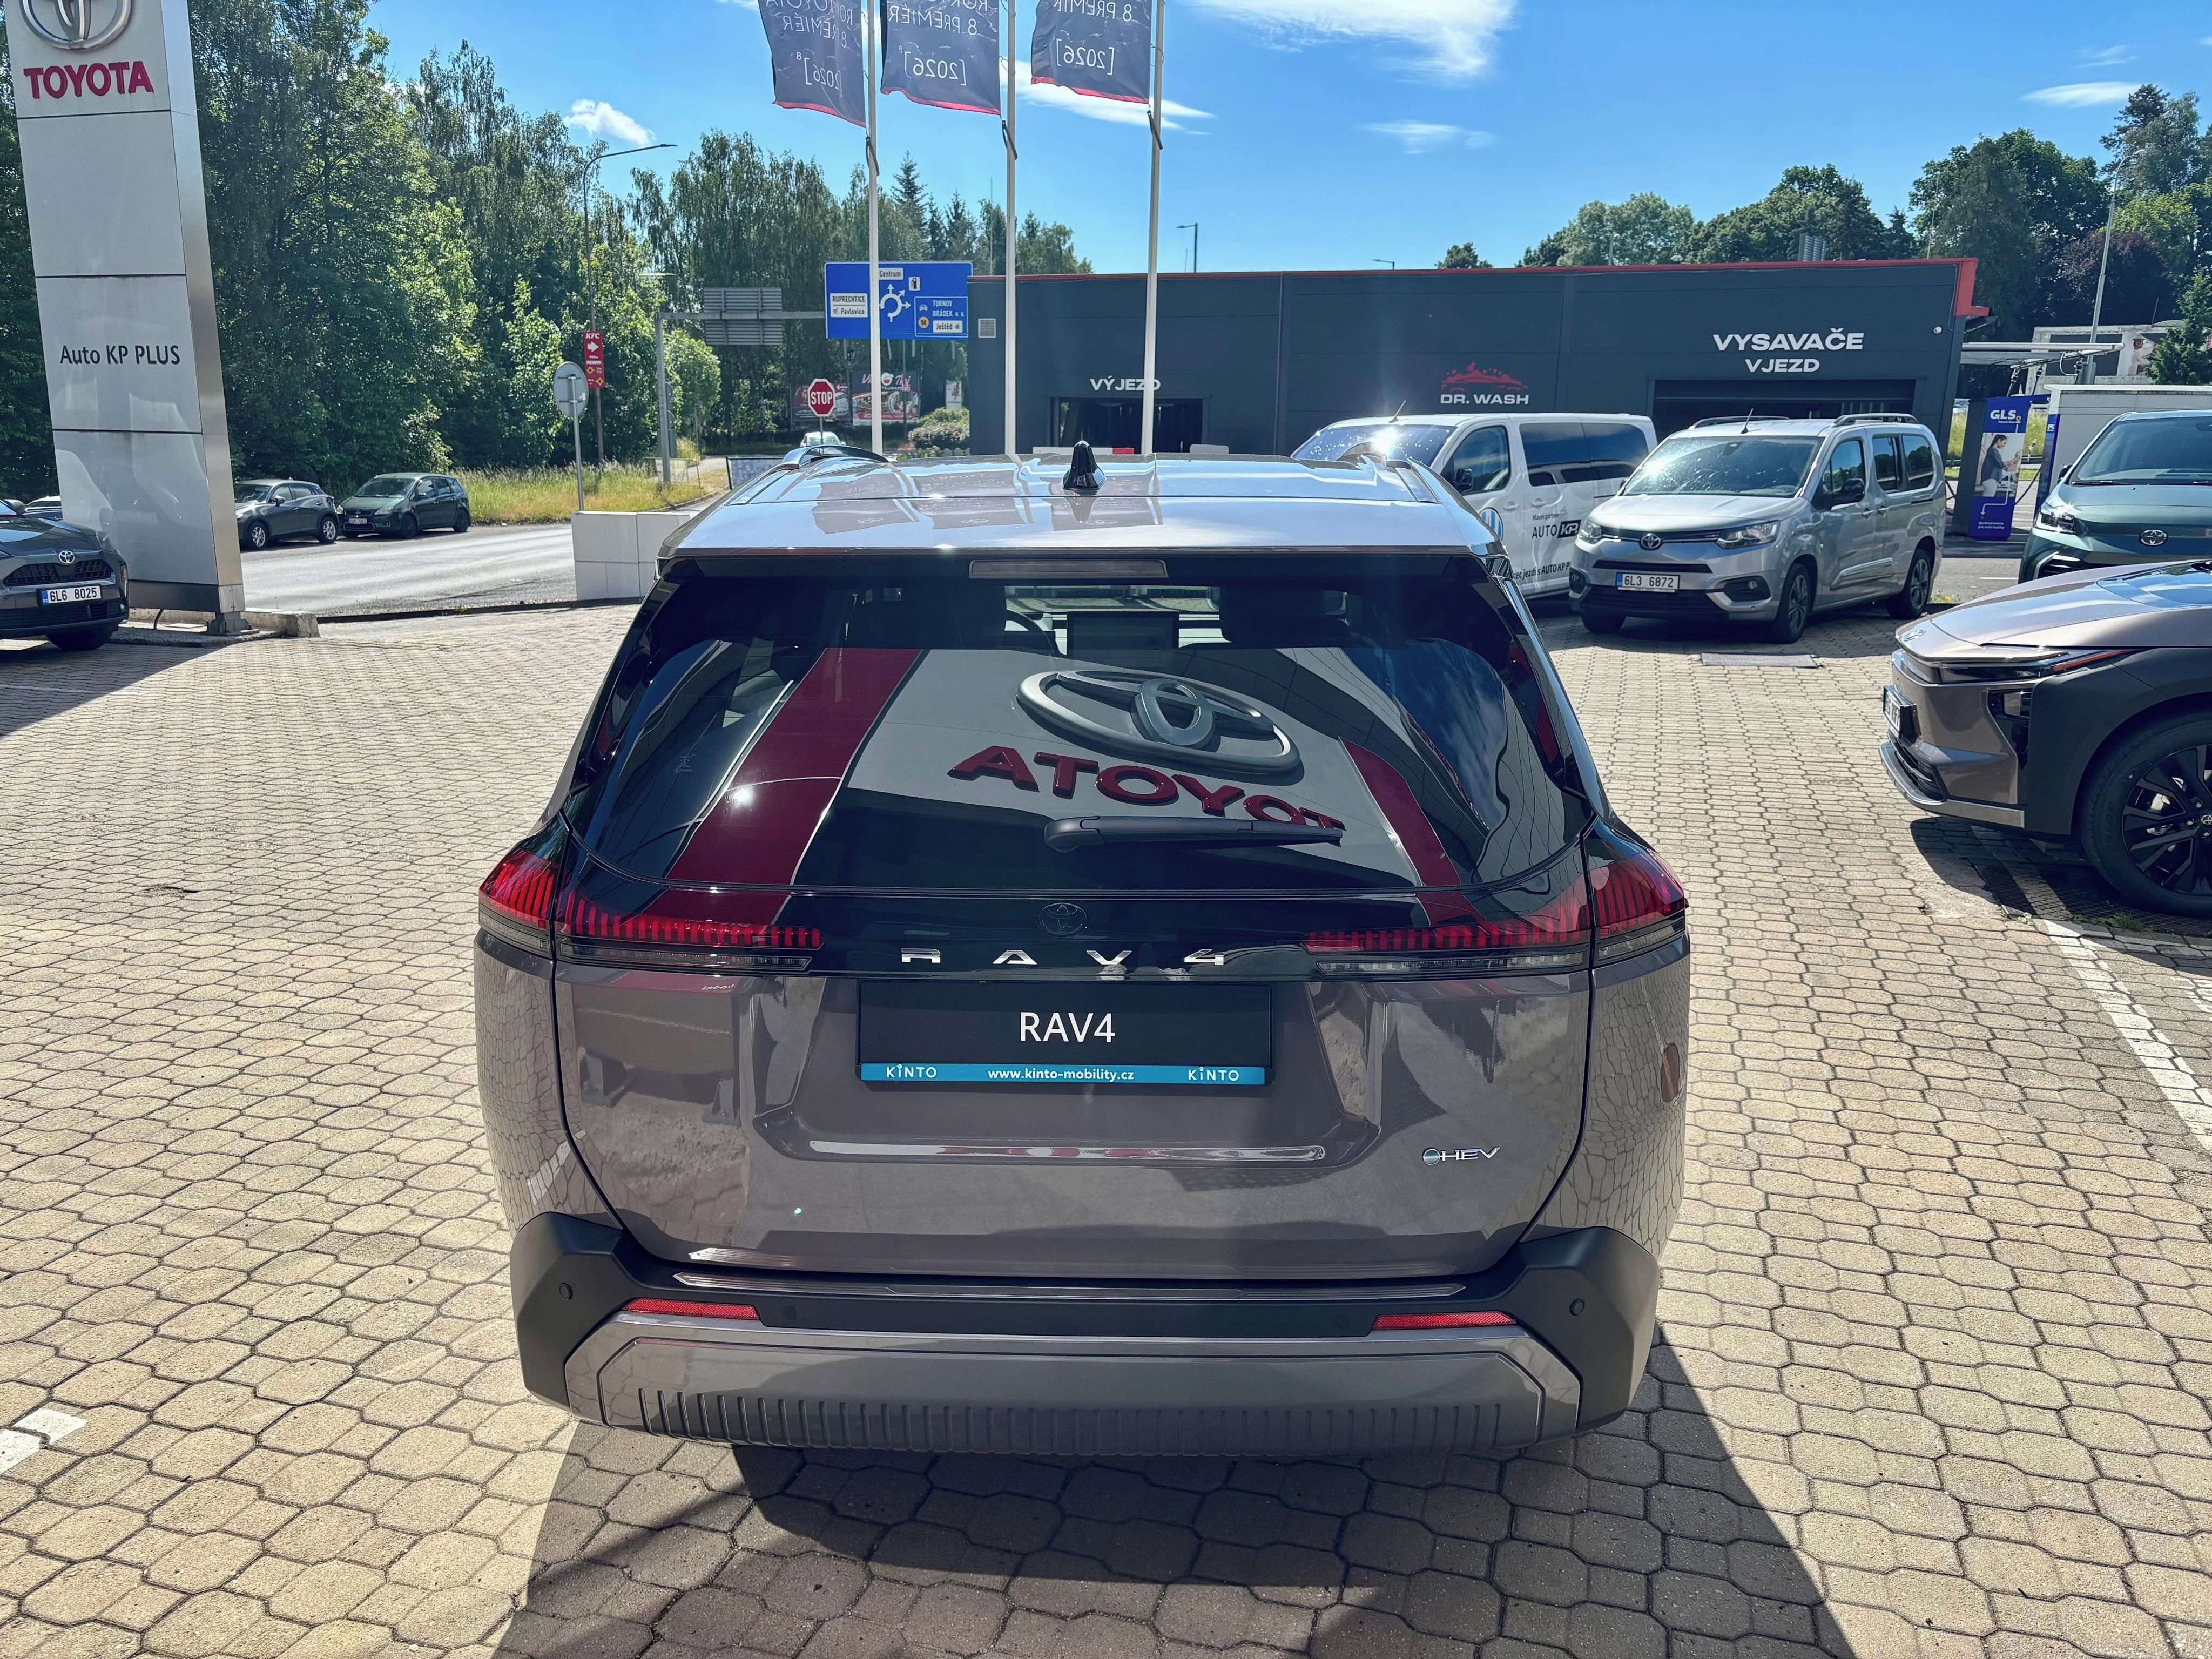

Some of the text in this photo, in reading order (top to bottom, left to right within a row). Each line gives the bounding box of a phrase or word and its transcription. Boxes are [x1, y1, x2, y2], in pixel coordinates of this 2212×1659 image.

[23, 61, 154, 99] TOYOTA
[1712, 328, 1864, 351] VYSAVAČE
[60, 345, 180, 365] Auto KP PLUS
[1745, 359, 1820, 373] VJEZD
[1089, 375, 1161, 390] VÝJEZD
[811, 391, 832, 405] STOP
[1440, 394, 1529, 404] DR. WASH
[1532, 524, 1557, 538] AUTO
[1541, 564, 1557, 574] AUTO
[1557, 562, 1565, 571] KP
[1624, 576, 1673, 588] 6L3 6872
[50, 588, 97, 602] 6L6 8025
[1020, 1012, 1115, 1043] RAV4
[988, 1067, 1134, 1082] www.kinto-mobility.cz
